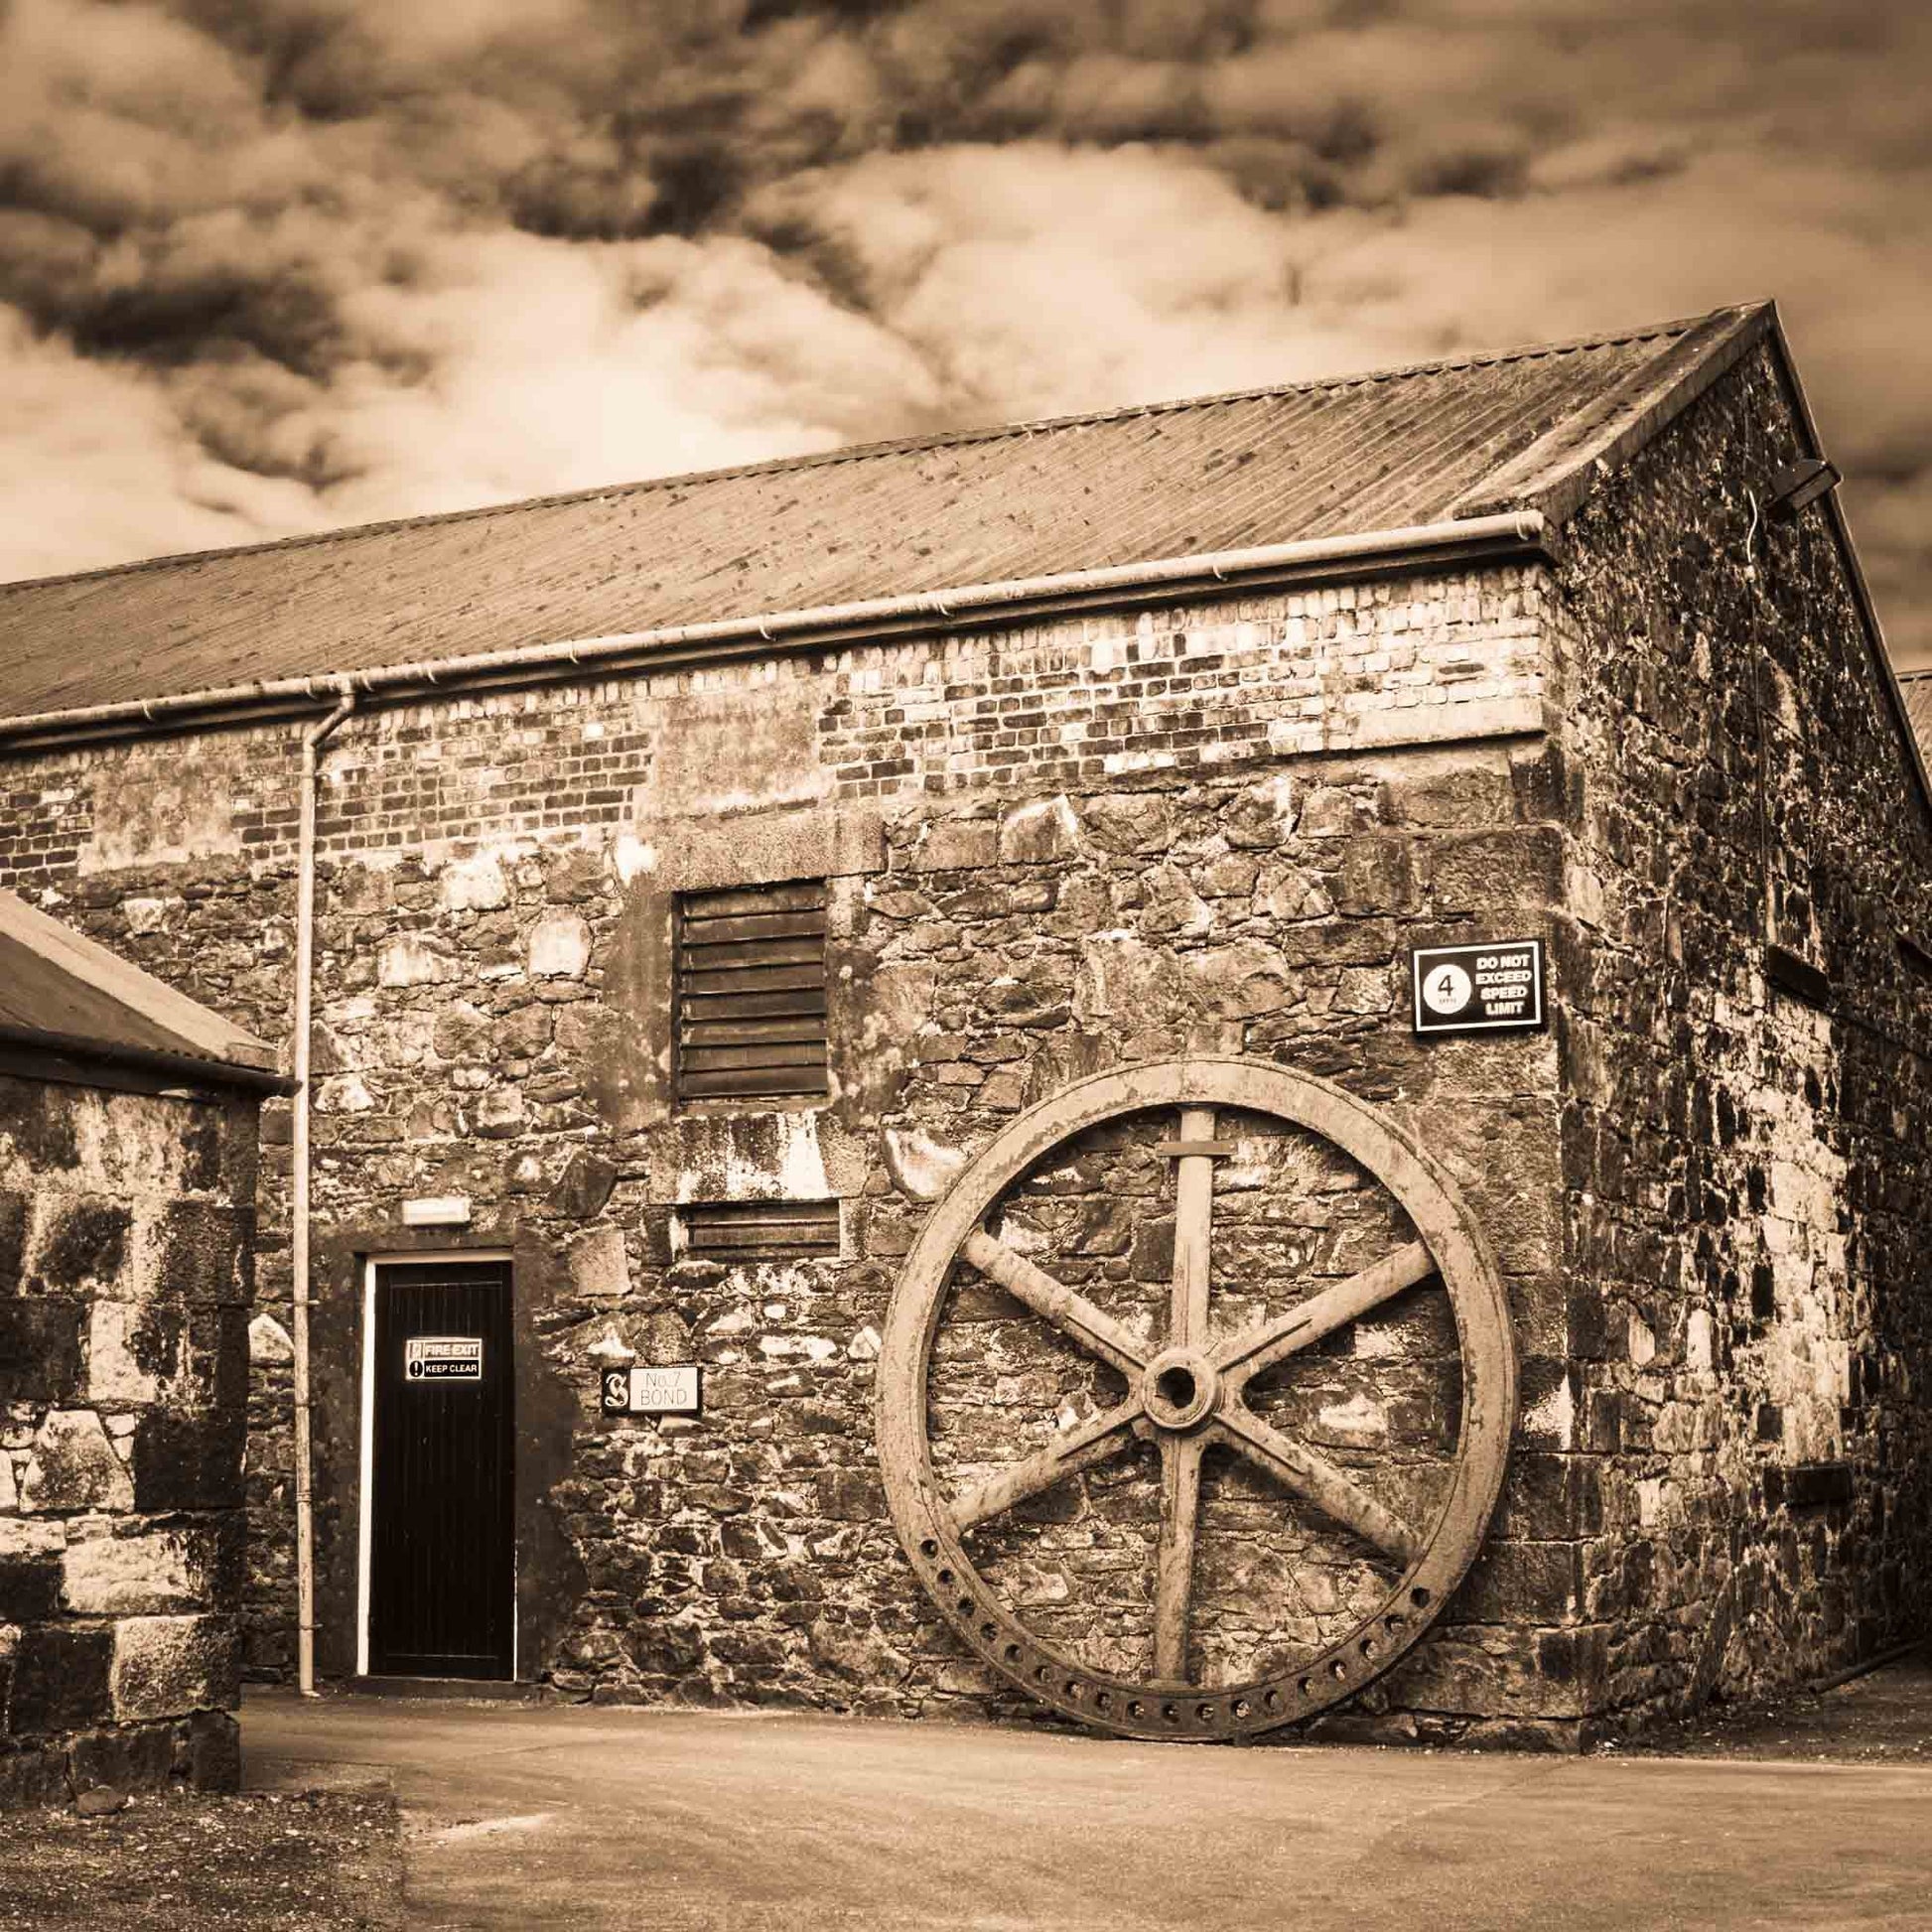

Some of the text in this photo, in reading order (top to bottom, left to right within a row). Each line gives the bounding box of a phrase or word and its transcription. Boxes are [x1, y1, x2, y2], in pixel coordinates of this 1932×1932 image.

[1476, 954, 1530, 970] DO NOT
[1438, 974, 1454, 996] 4
[1475, 970, 1532, 985] EXCEED
[1480, 985, 1528, 1000] SPEED
[1485, 1001, 1524, 1016] LIMIT
[425, 1344, 479, 1356] FIRE EXIT
[425, 1364, 478, 1373] KEEP CLEAR
[640, 1388, 687, 1406] BOND
